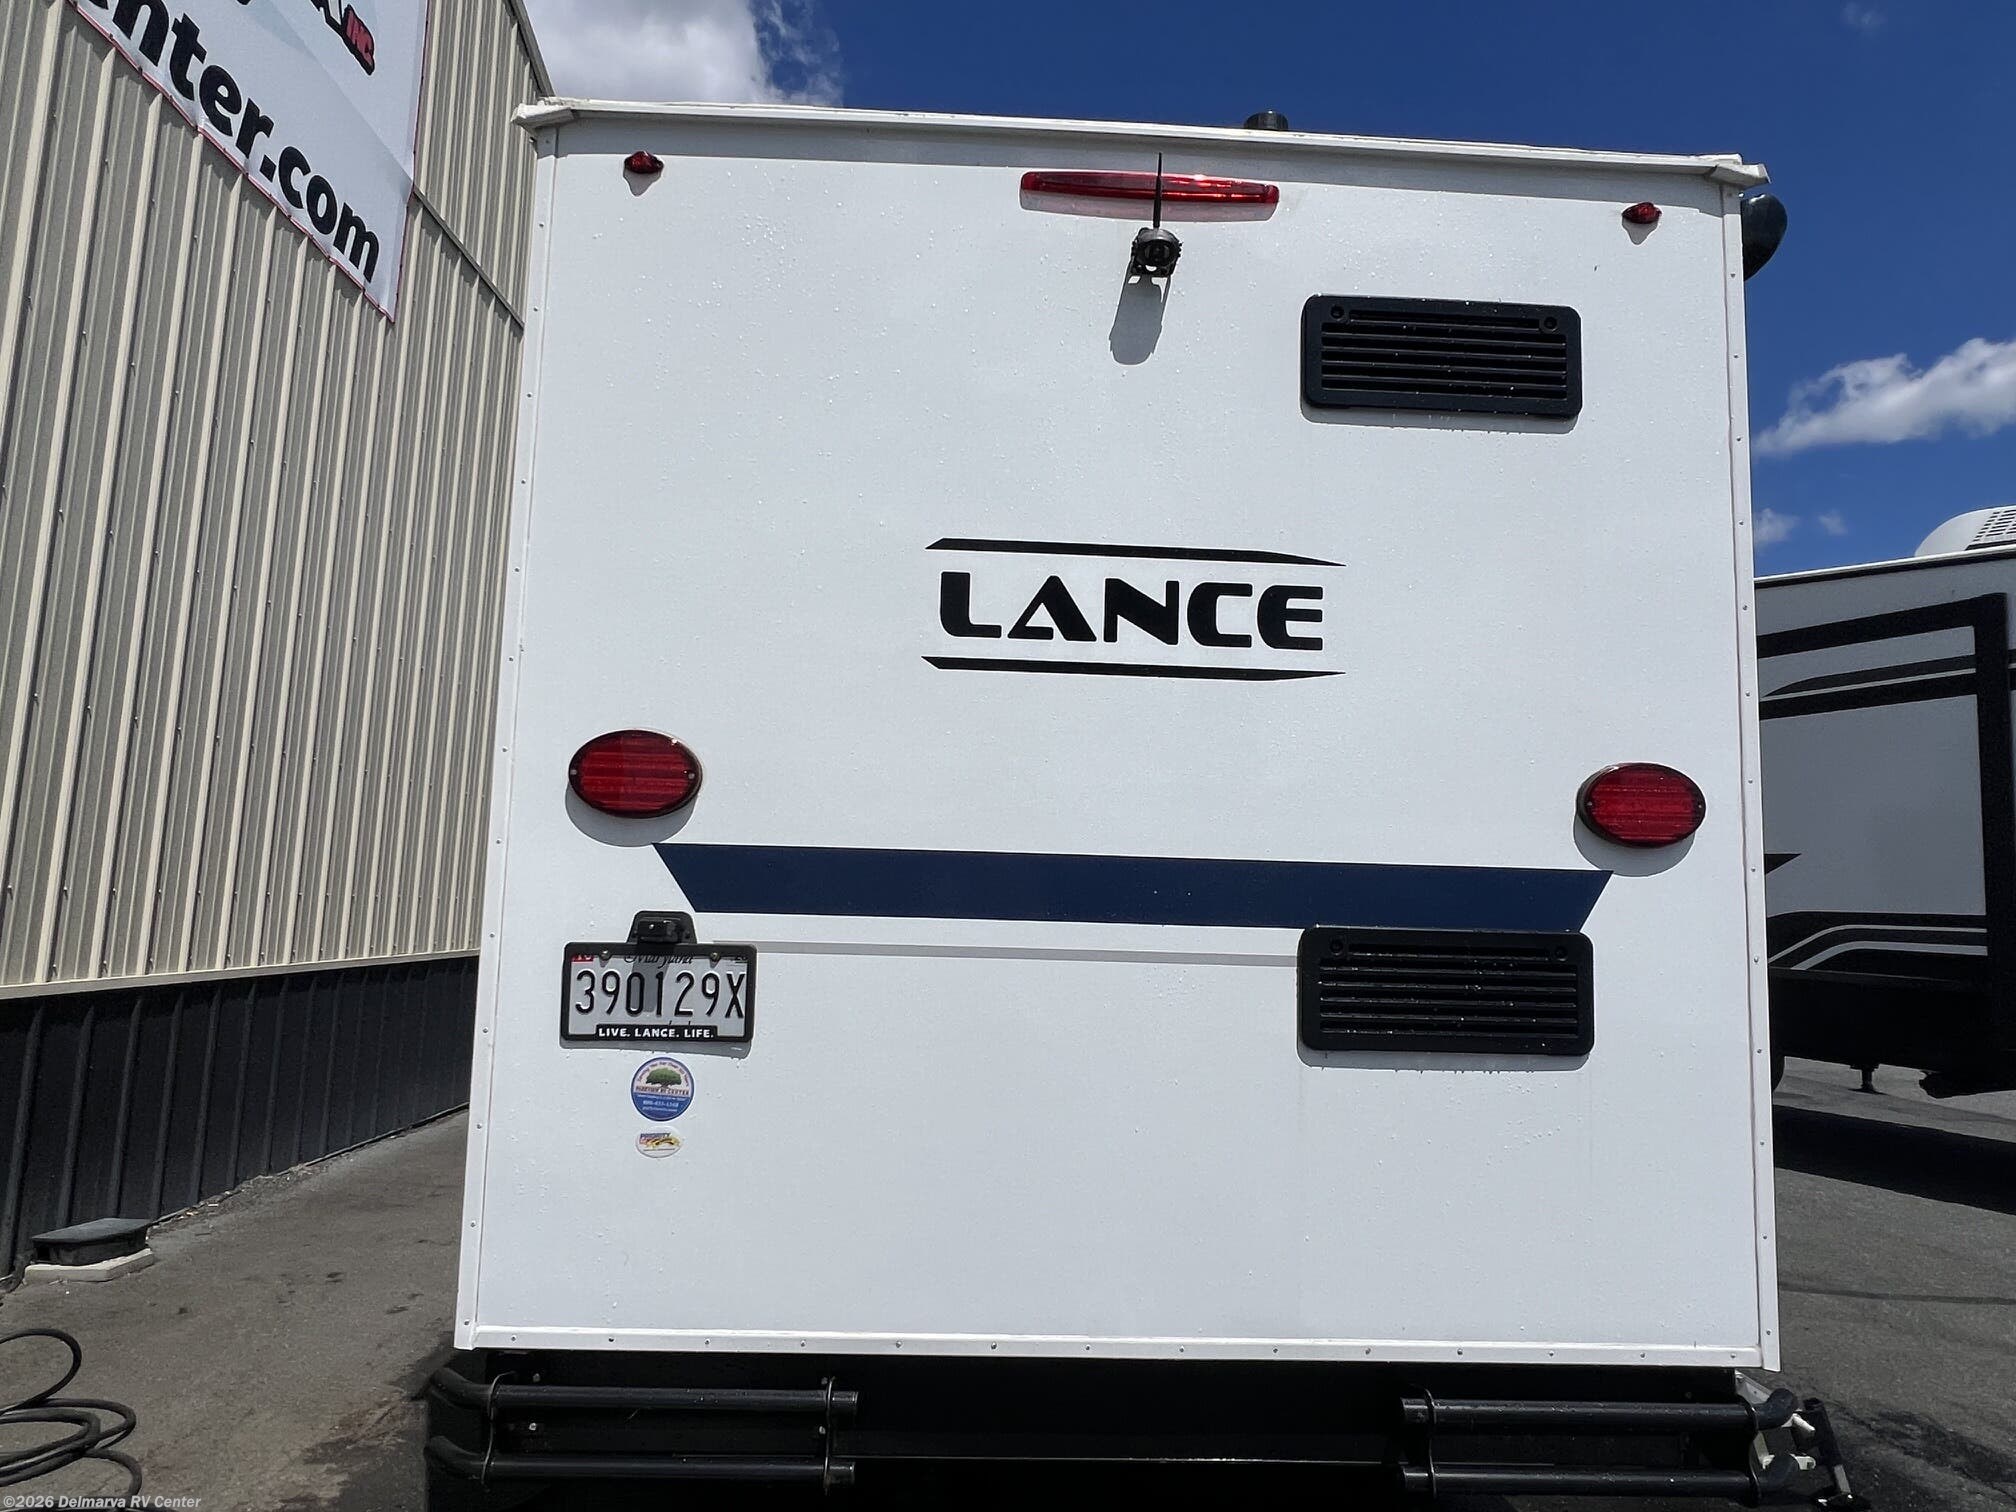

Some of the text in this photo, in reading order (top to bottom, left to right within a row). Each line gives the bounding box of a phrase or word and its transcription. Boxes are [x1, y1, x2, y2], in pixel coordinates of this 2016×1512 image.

[89, 0, 380, 284] nter.com
[940, 571, 1324, 651] LANCE
[575, 970, 746, 1019] 390129X
[598, 1027, 714, 1039] LIVE. LANCE. LIFE.
